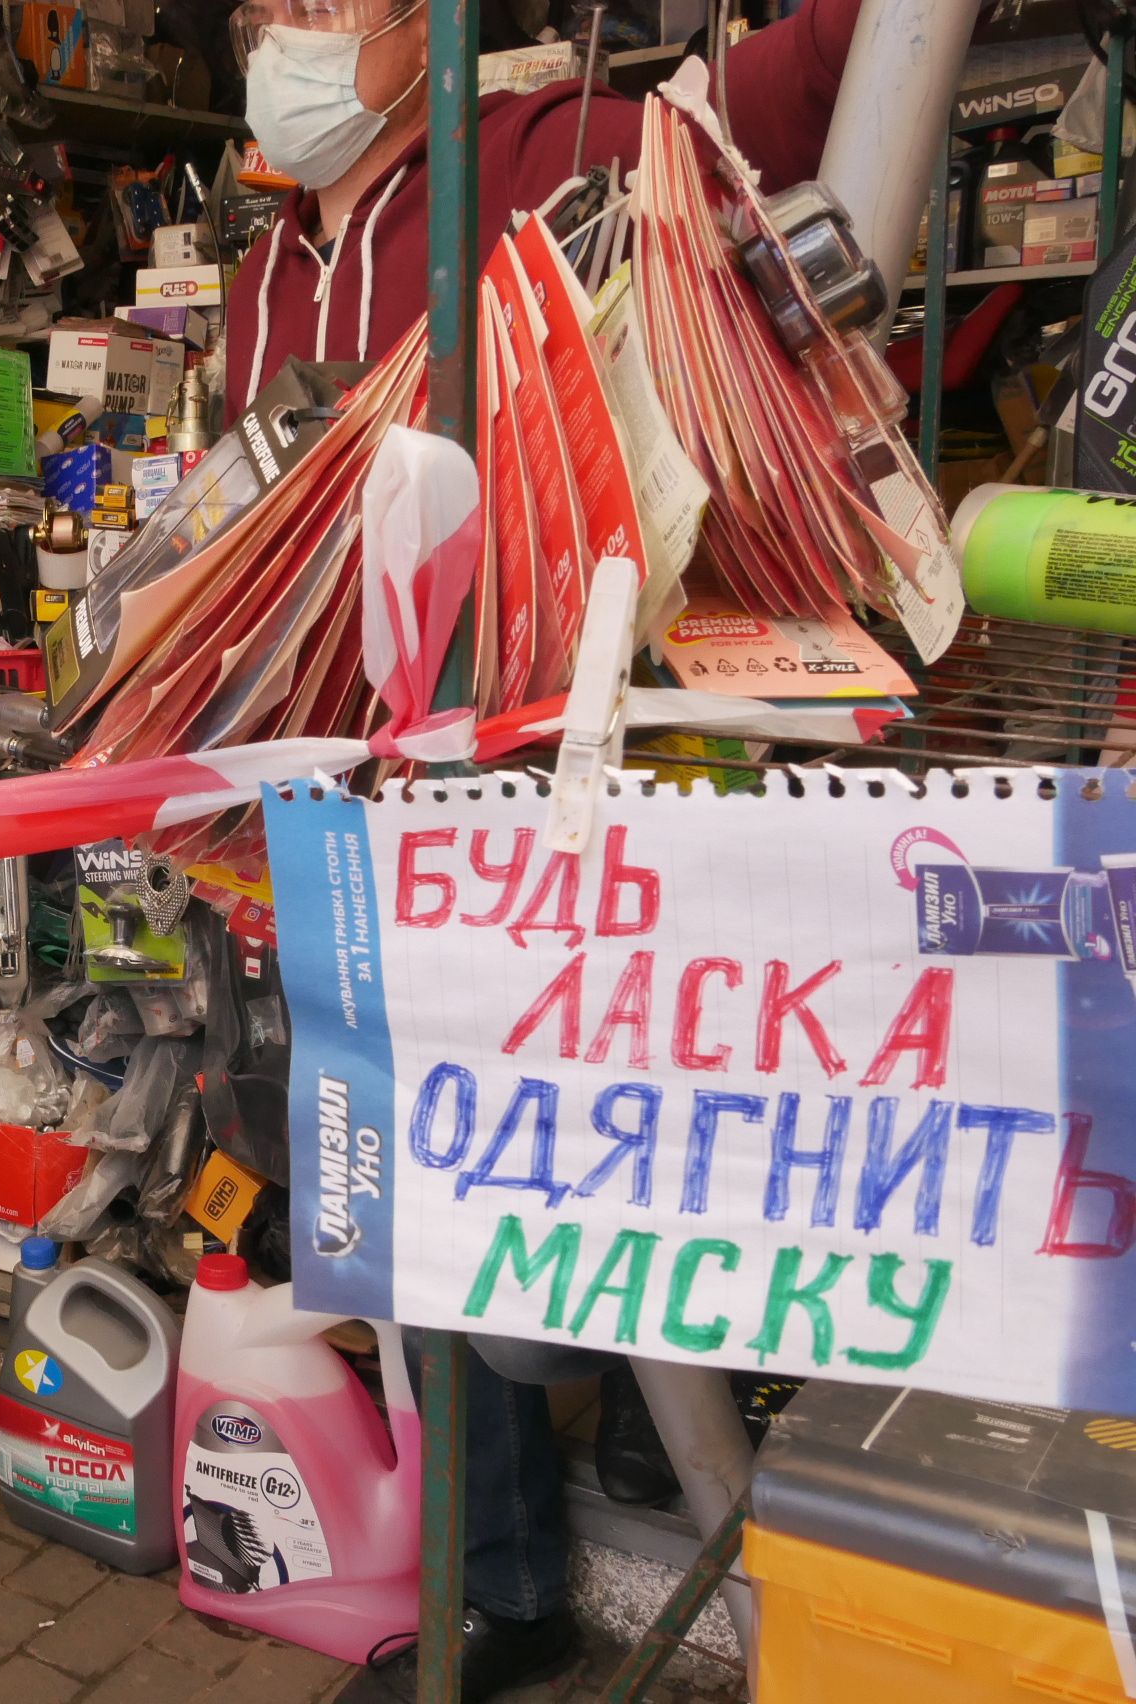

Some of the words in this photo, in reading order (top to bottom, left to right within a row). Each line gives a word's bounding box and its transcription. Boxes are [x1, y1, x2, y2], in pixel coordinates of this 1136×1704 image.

[984, 185, 1035, 201] MOTUL
[987, 208, 1024, 225] 10W-4
[84, 361, 102, 371] PUMP
[104, 395, 135, 414] PUMP
[242, 412, 256, 439] CAR
[249, 437, 282, 485] PERFUME
[75, 597, 94, 660] PREMIUM
[678, 617, 755, 629] PREMIUM
[680, 625, 760, 638] PARFUMS
[77, 851, 143, 872] WiNS
[324, 831, 339, 886] СТОПИ
[895, 828, 928, 872] НОВИНКА!
[84, 869, 121, 884] STEERING
[343, 832, 369, 944] НАНЕСЕННЯ
[395, 823, 662, 951] БУДЬ
[330, 888, 348, 947] ГРИБКА
[923, 871, 941, 946] ЛАМІЗИЛ
[940, 892, 958, 926] УНО
[333, 950, 359, 1030] ЛІКУВАННЯ
[357, 958, 373, 983] ЗА
[501, 949, 955, 1090] ЛАСКА
[318, 1075, 350, 1244] ЛАМІЗИЛ
[351, 1127, 382, 1199] УНО
[407, 1060, 1136, 1260] ОДЯГНИТЬ
[462, 1213, 954, 1372] МАСКУ
[216, 1417, 259, 1441] VAMP
[45, 1475, 104, 1494] normal
[195, 1460, 258, 1490] ANTIFREEZE
[265, 1476, 297, 1499] G12+
